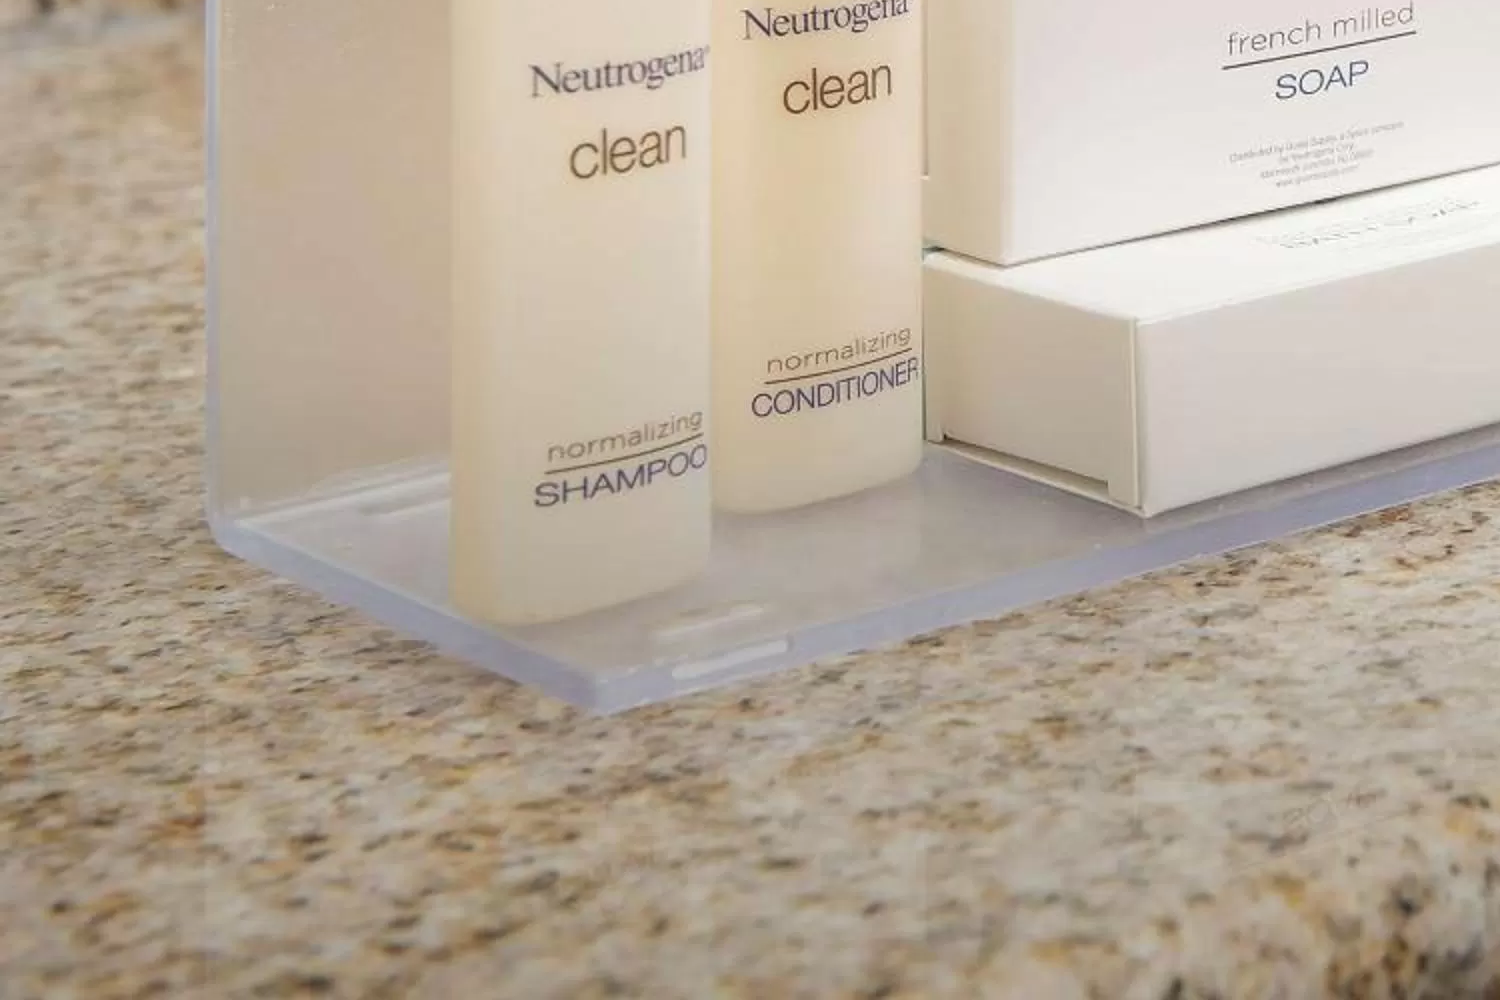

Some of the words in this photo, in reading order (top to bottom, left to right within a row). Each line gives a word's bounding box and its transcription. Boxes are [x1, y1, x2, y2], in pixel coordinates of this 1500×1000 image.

[1227, 19, 1321, 55] french
[1333, 0, 1415, 38] milled
[783, 65, 893, 115] clean
[1275, 60, 1369, 100] SOAP
[569, 126, 687, 179] clean
[766, 327, 911, 373] normalizing
[751, 356, 919, 418] CONDITIONER
[547, 411, 703, 462] normalizing
[534, 443, 708, 507] SHAMPOO
